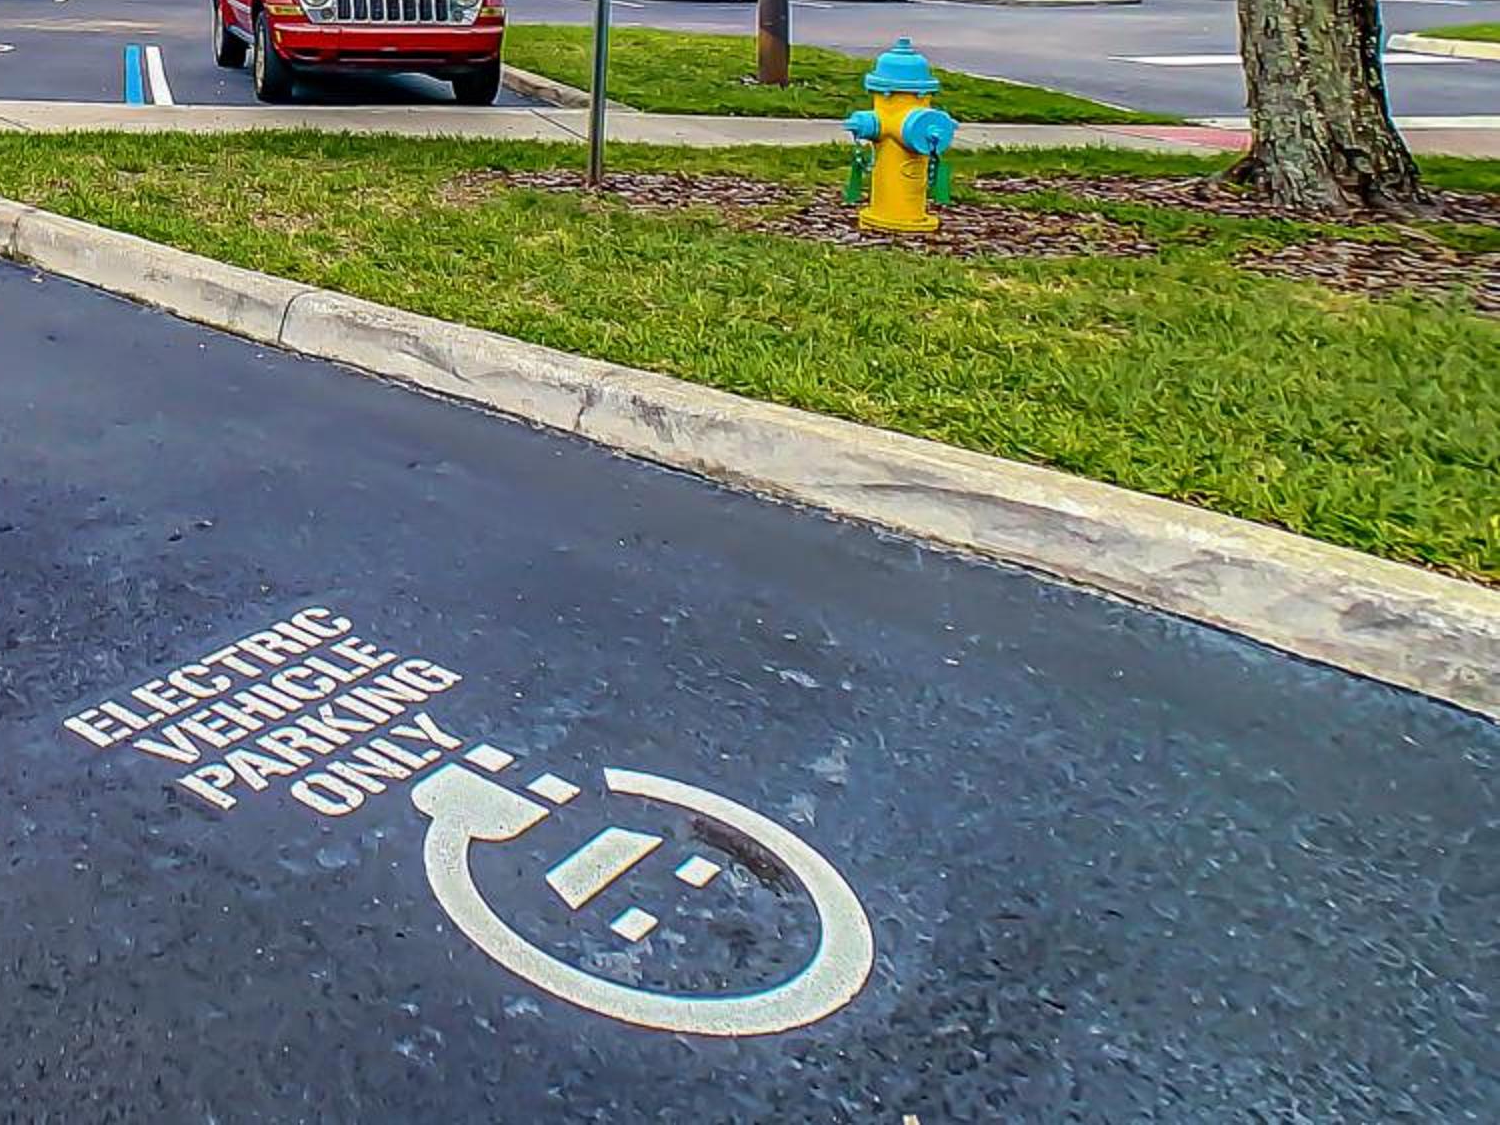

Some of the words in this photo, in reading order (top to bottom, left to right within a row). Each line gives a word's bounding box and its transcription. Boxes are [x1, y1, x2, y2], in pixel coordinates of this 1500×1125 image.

[63, 606, 352, 748] ELECTRIC
[133, 636, 397, 764] VEHICLE
[177, 659, 463, 810] PARKING
[290, 711, 463, 817] ONLY
